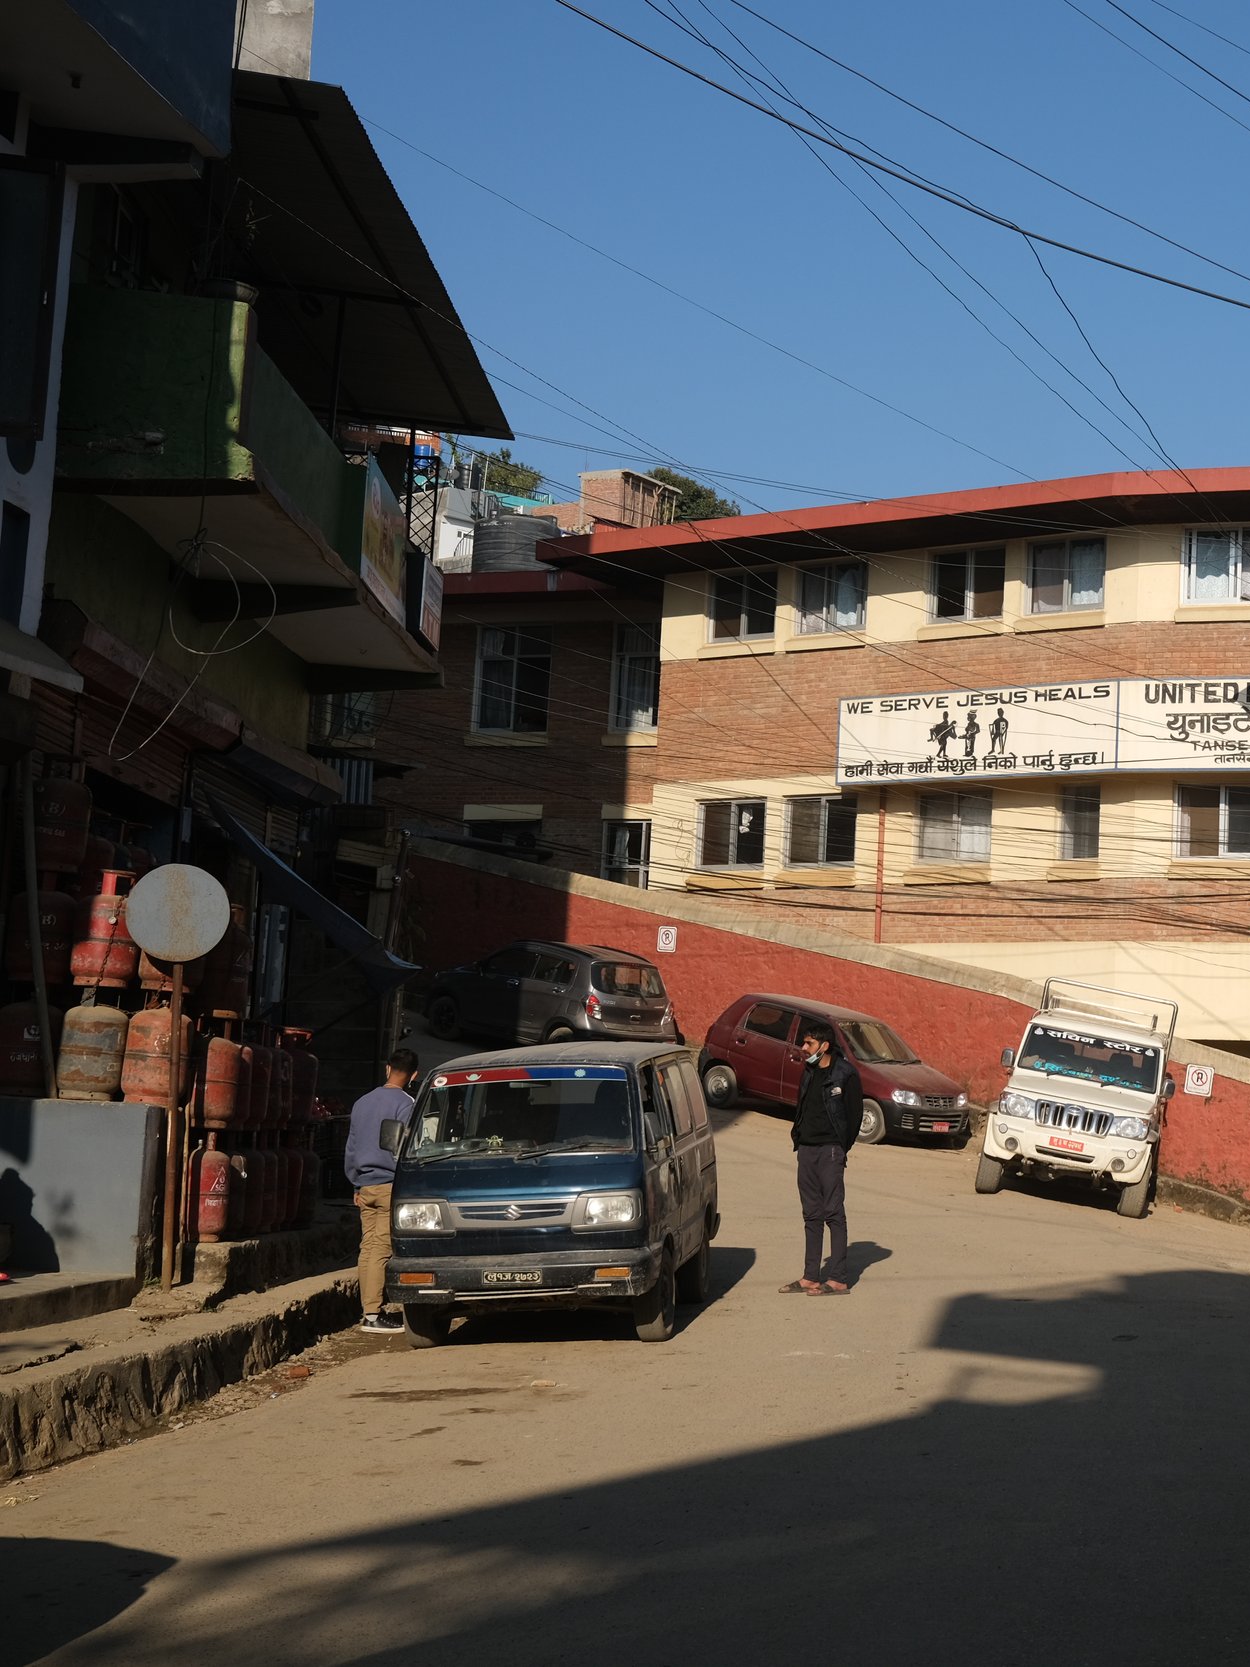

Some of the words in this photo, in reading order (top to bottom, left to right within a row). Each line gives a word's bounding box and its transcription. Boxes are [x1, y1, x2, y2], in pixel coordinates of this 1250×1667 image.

[847, 701, 874, 715] WE
[879, 696, 949, 713] SERVE
[956, 690, 1028, 707] JESUS
[1034, 684, 1111, 702] HEALS
[1144, 682, 1240, 704] UNITED
[844, 760, 874, 778] हामी
[877, 759, 904, 776] सेवा
[937, 755, 978, 776] येशुले
[982, 752, 1018, 771] निको
[1022, 749, 1055, 771] पार्नु
